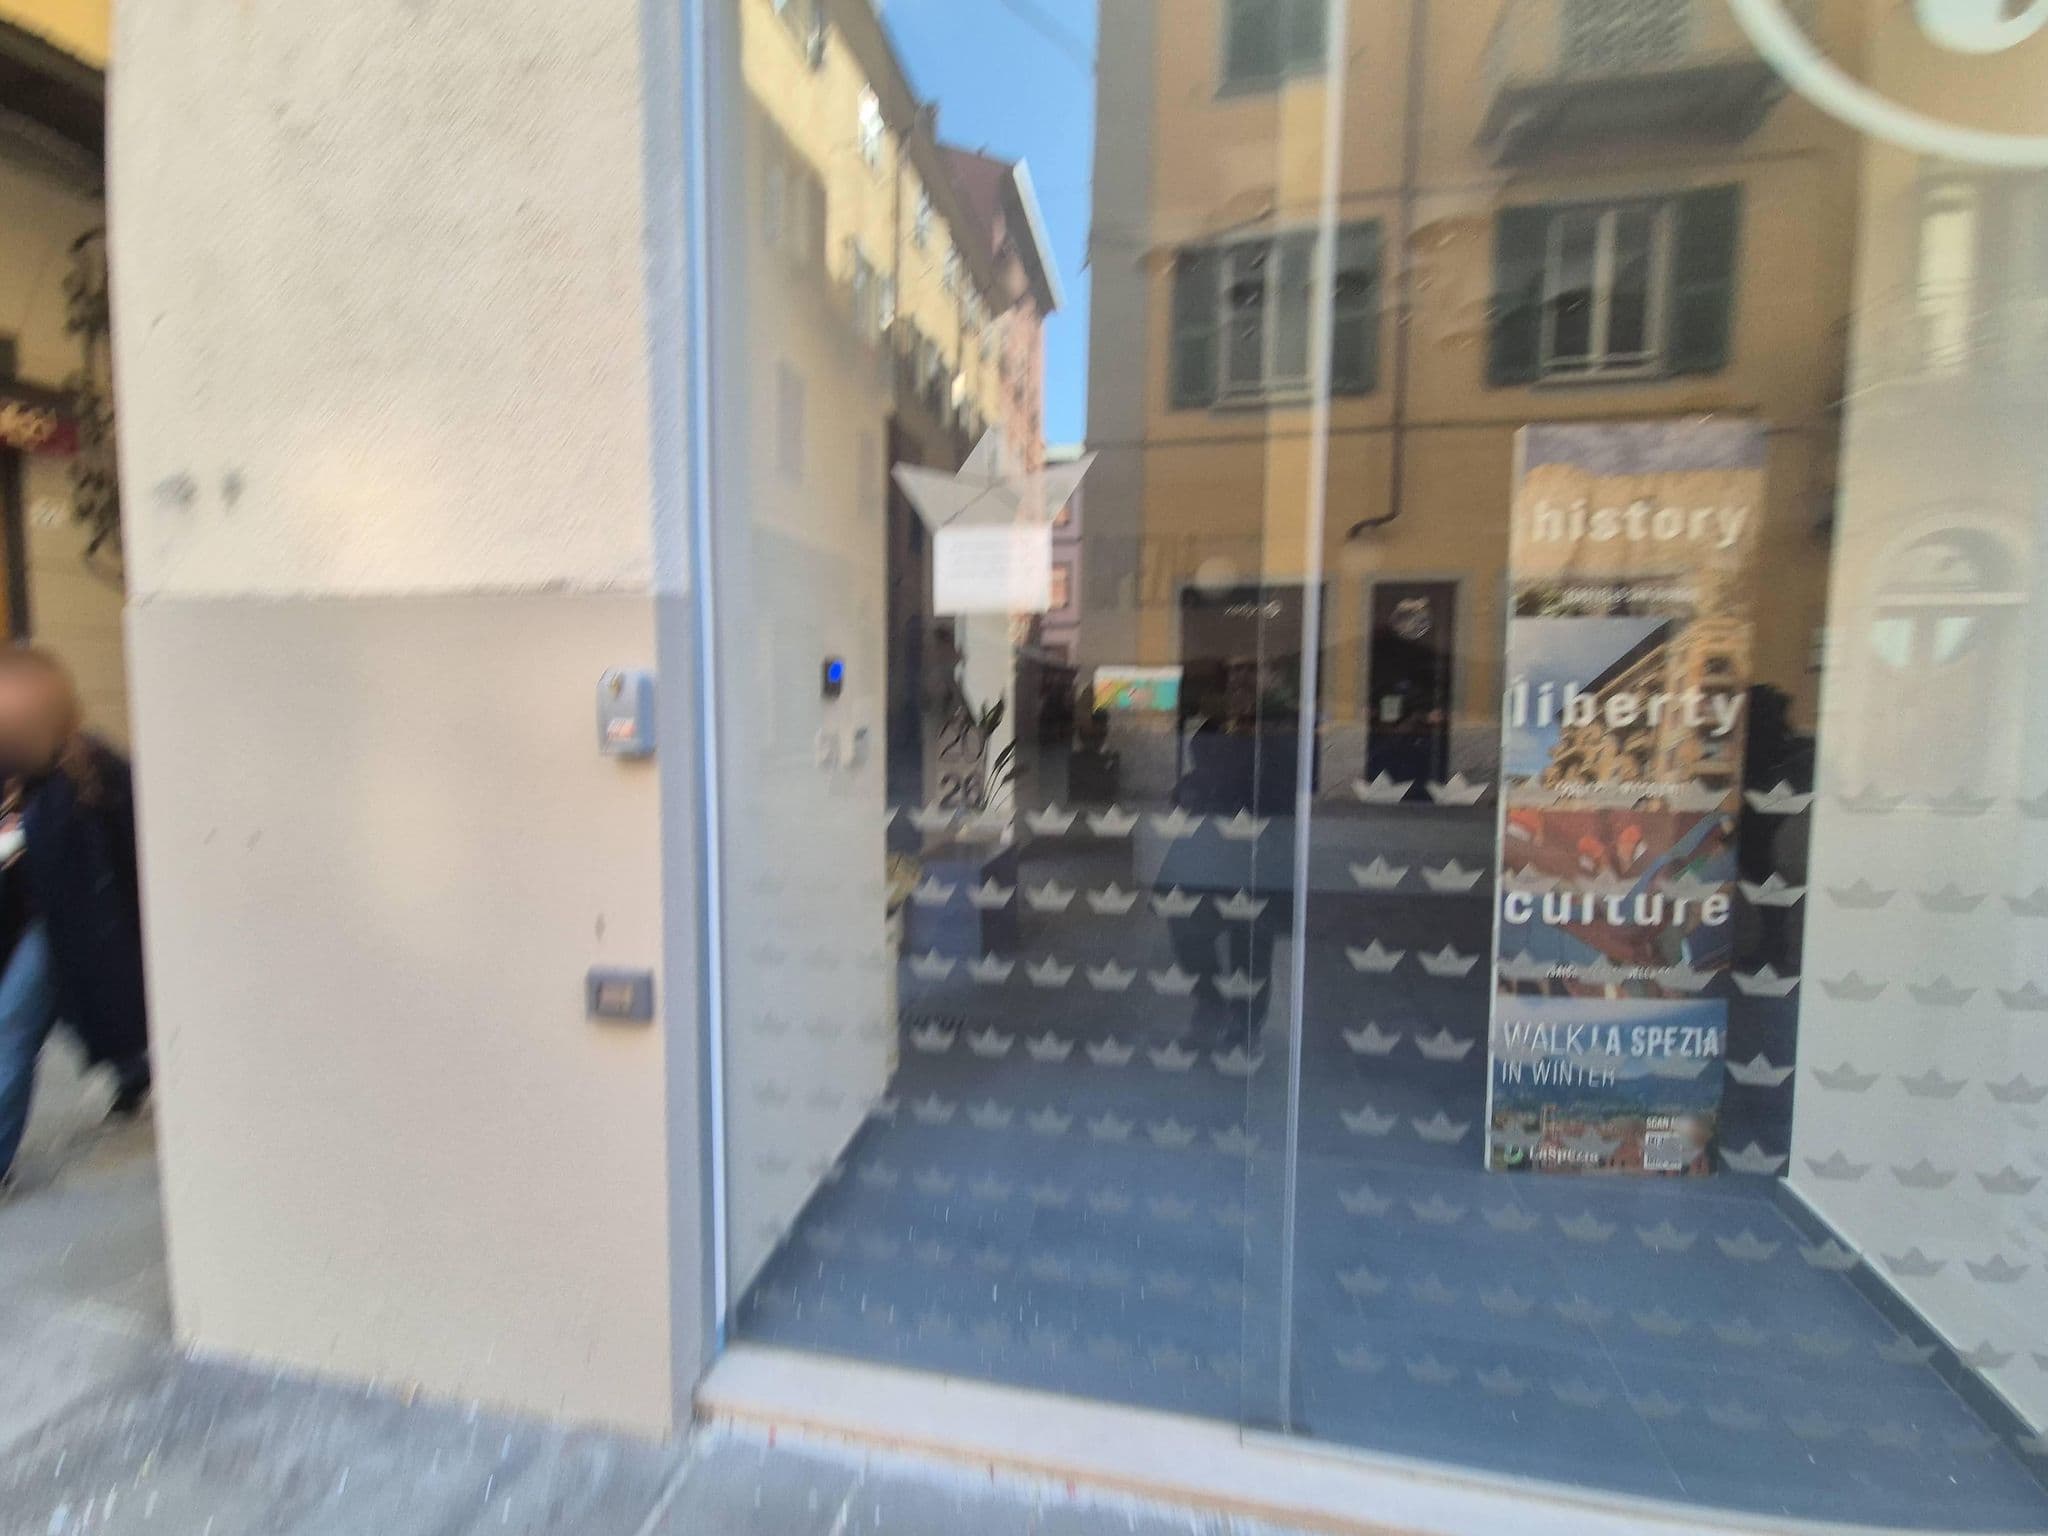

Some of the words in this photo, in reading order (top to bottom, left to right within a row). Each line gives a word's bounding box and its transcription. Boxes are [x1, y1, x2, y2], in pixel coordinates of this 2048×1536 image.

[1530, 498, 1748, 549] history
[1511, 676, 1746, 737] liberty
[1503, 889, 1730, 926] culture
[1504, 1021, 1585, 1056] WALK
[1630, 1025, 1720, 1057] SPEZIA
[1502, 1059, 1522, 1086] IN
